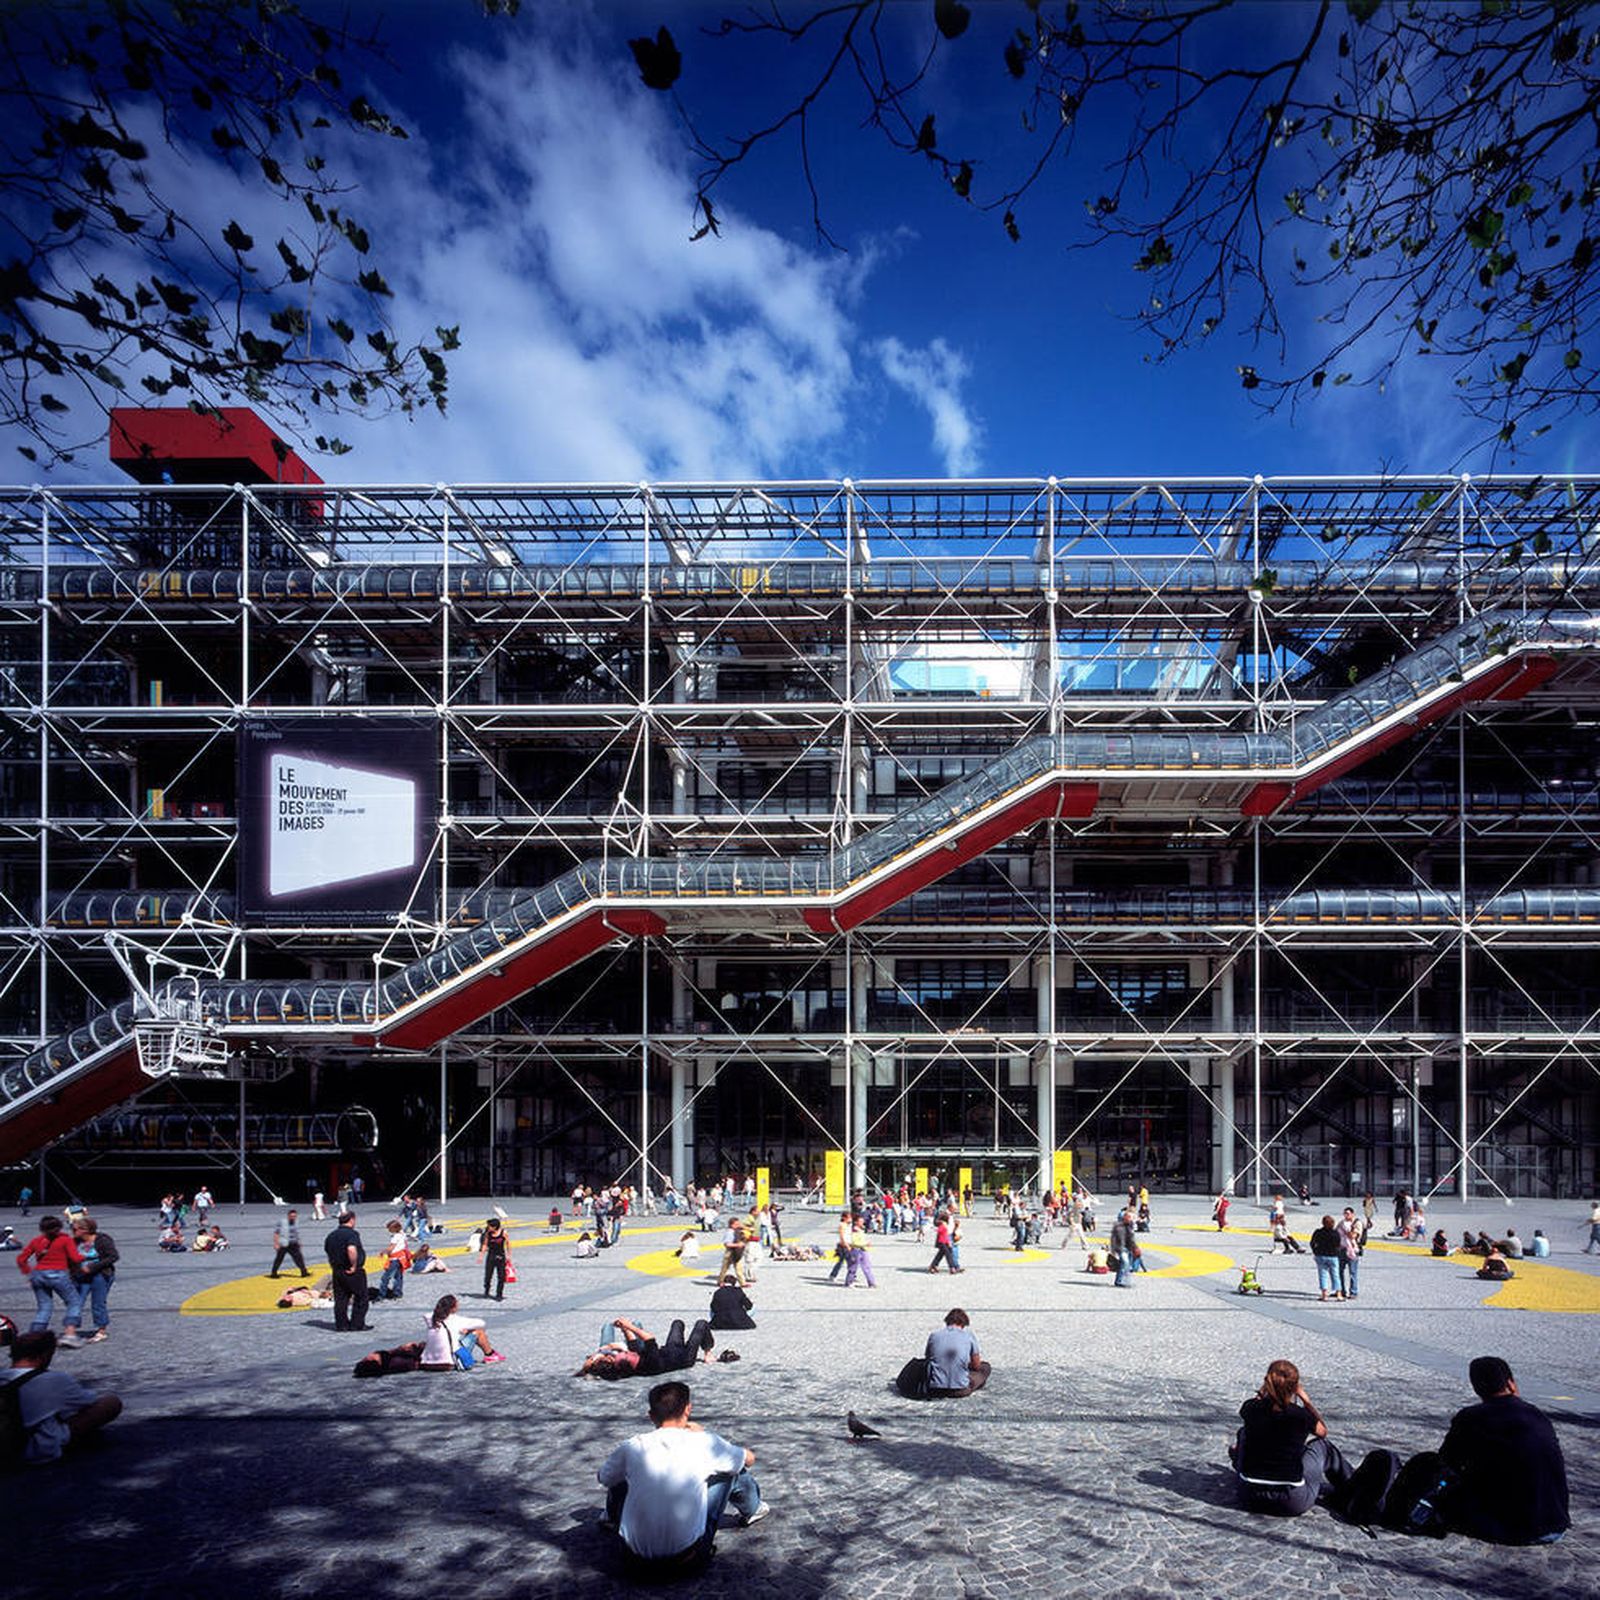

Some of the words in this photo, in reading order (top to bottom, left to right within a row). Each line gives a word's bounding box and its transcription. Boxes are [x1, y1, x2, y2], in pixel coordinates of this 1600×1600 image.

[279, 766, 295, 783] LE
[279, 784, 347, 801] MOUVEMENT
[279, 801, 304, 815] DES
[279, 816, 325, 831] IMAGES
